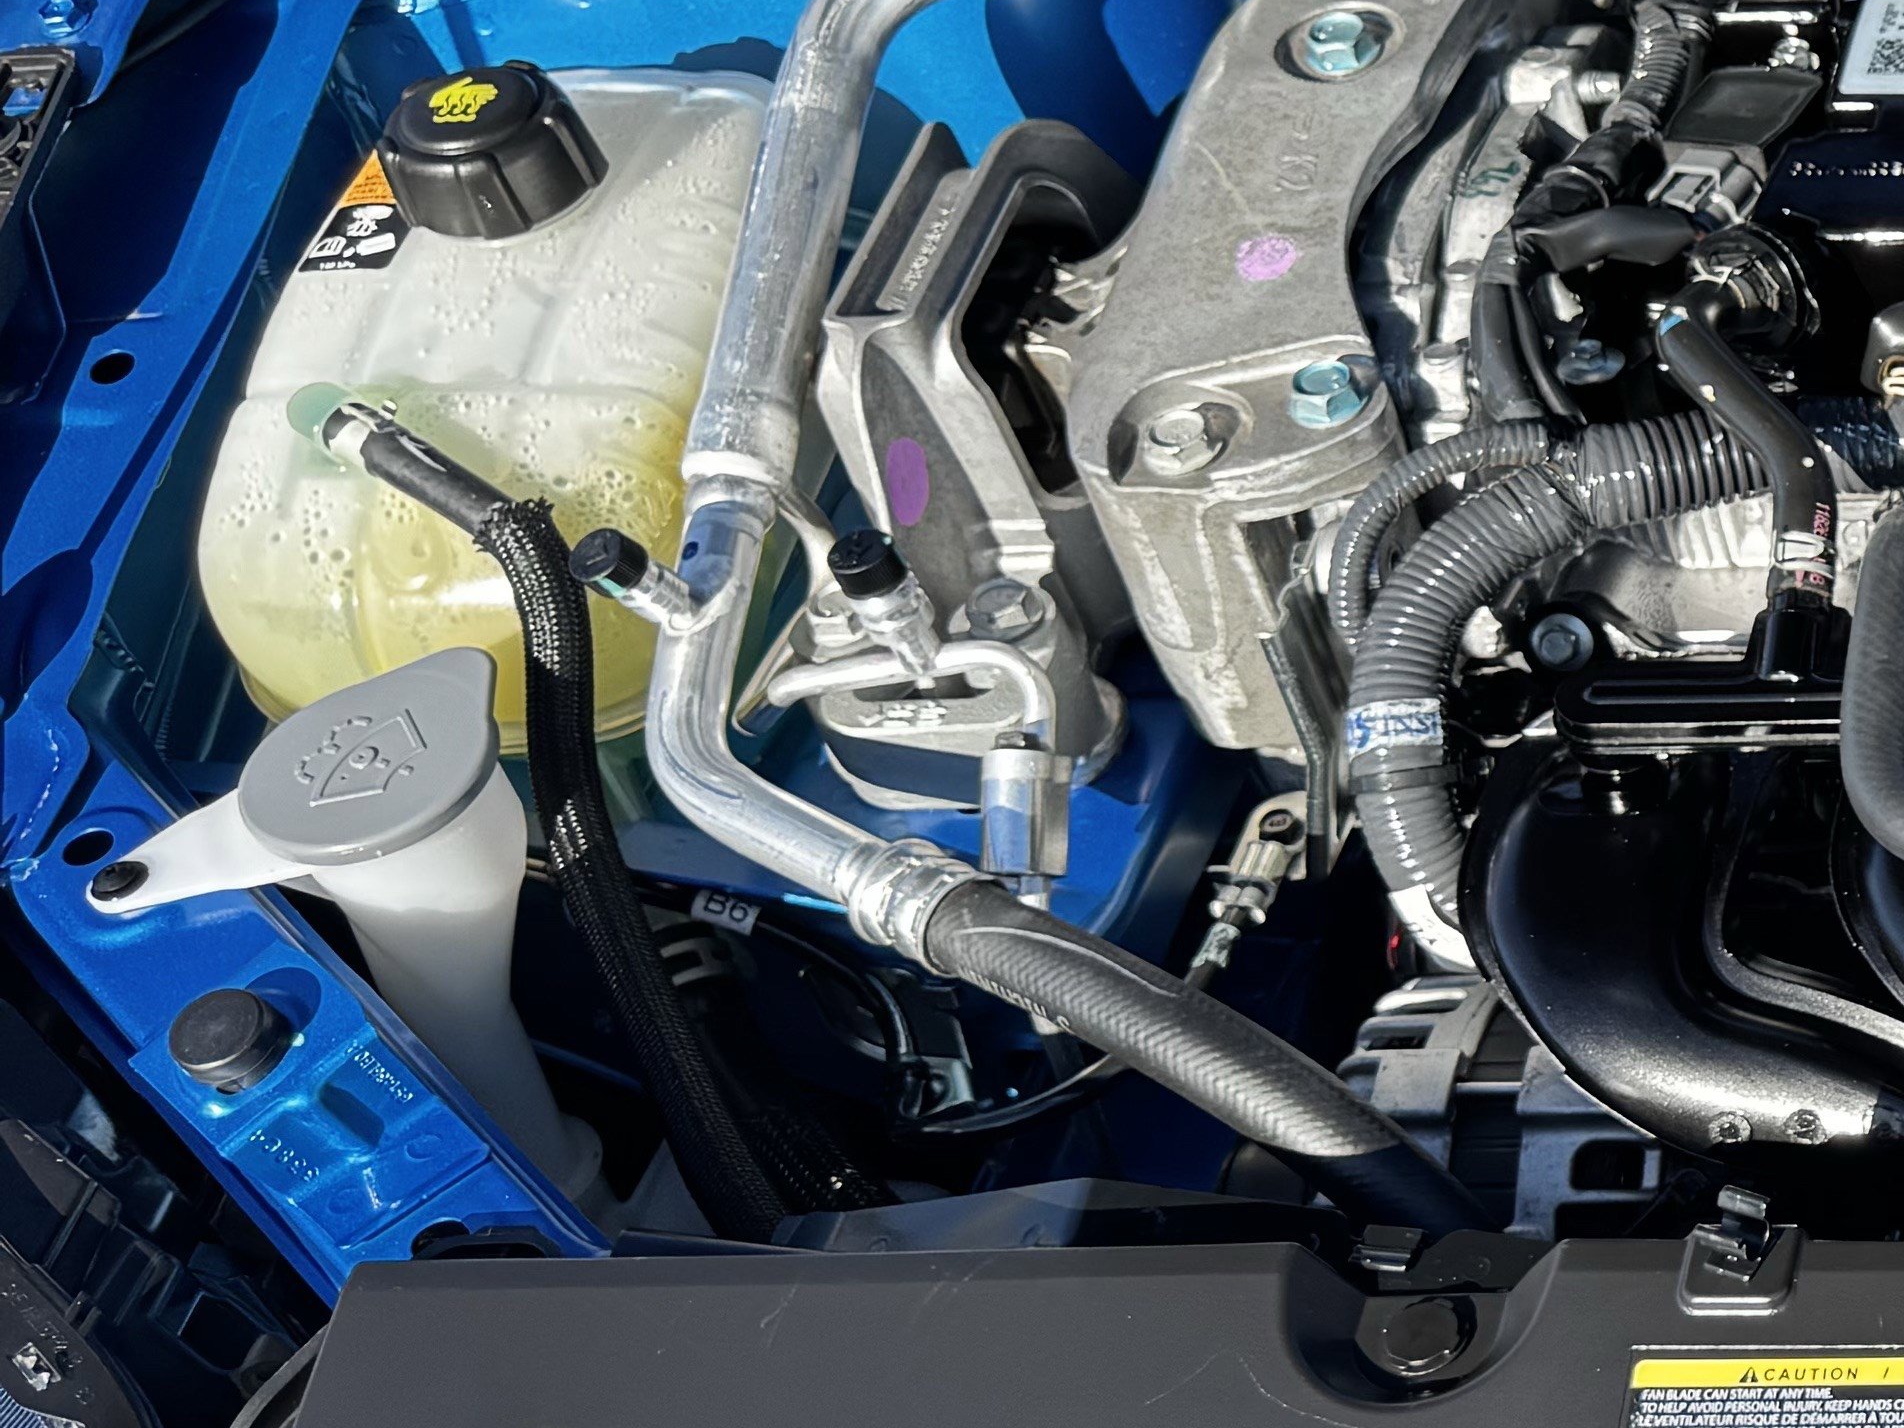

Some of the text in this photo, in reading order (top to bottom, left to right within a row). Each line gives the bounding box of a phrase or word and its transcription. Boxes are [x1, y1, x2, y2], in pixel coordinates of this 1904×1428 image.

[1763, 1367, 1859, 1382] CAUTION
[1641, 1387, 1834, 1401] FAN BLADE CAN START AT ANY TIME.
[1641, 1402, 1657, 1413] TO
[1659, 1401, 1687, 1413] HELP
[1688, 1401, 1723, 1413] AVOID
[1724, 1401, 1781, 1412] PERSONAL
[1825, 1400, 1852, 1411] KEEP
[1853, 1399, 1892, 1410] HANDS
[1654, 1414, 1734, 1426] VENTILATEUR
[1735, 1413, 1779, 1425] RISQUE
[1780, 1413, 1798, 1425] DE
